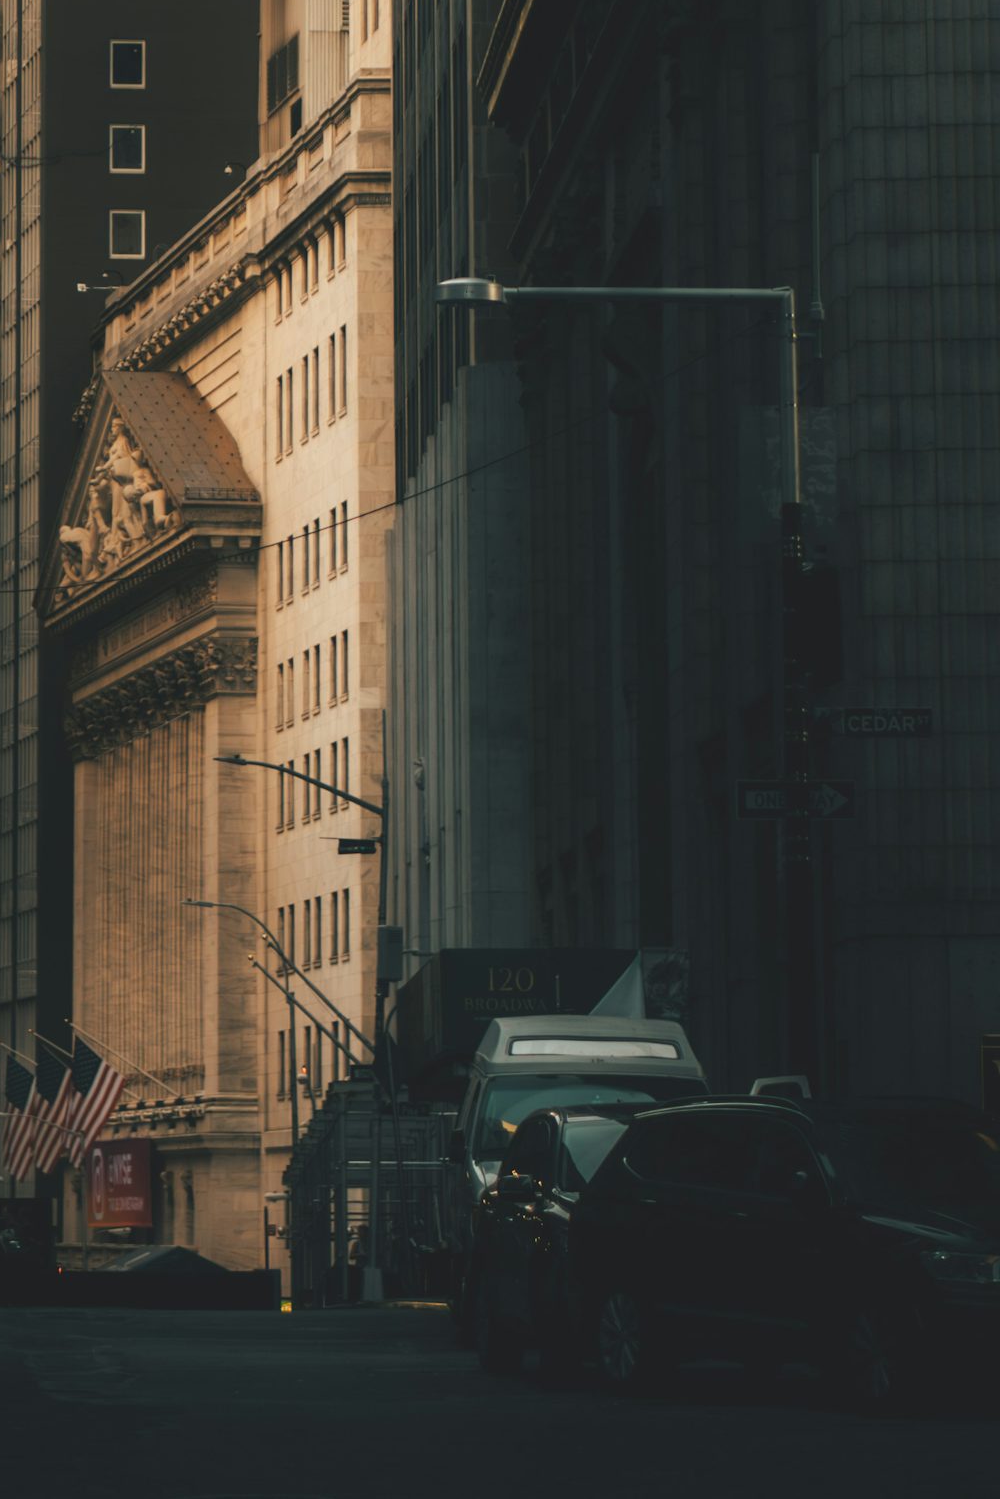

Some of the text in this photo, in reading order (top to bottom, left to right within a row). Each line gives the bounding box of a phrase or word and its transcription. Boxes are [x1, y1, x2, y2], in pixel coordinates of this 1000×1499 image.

[847, 715, 916, 733] CEDAR
[487, 966, 535, 992] 120
[464, 997, 549, 1012] BROADWA
